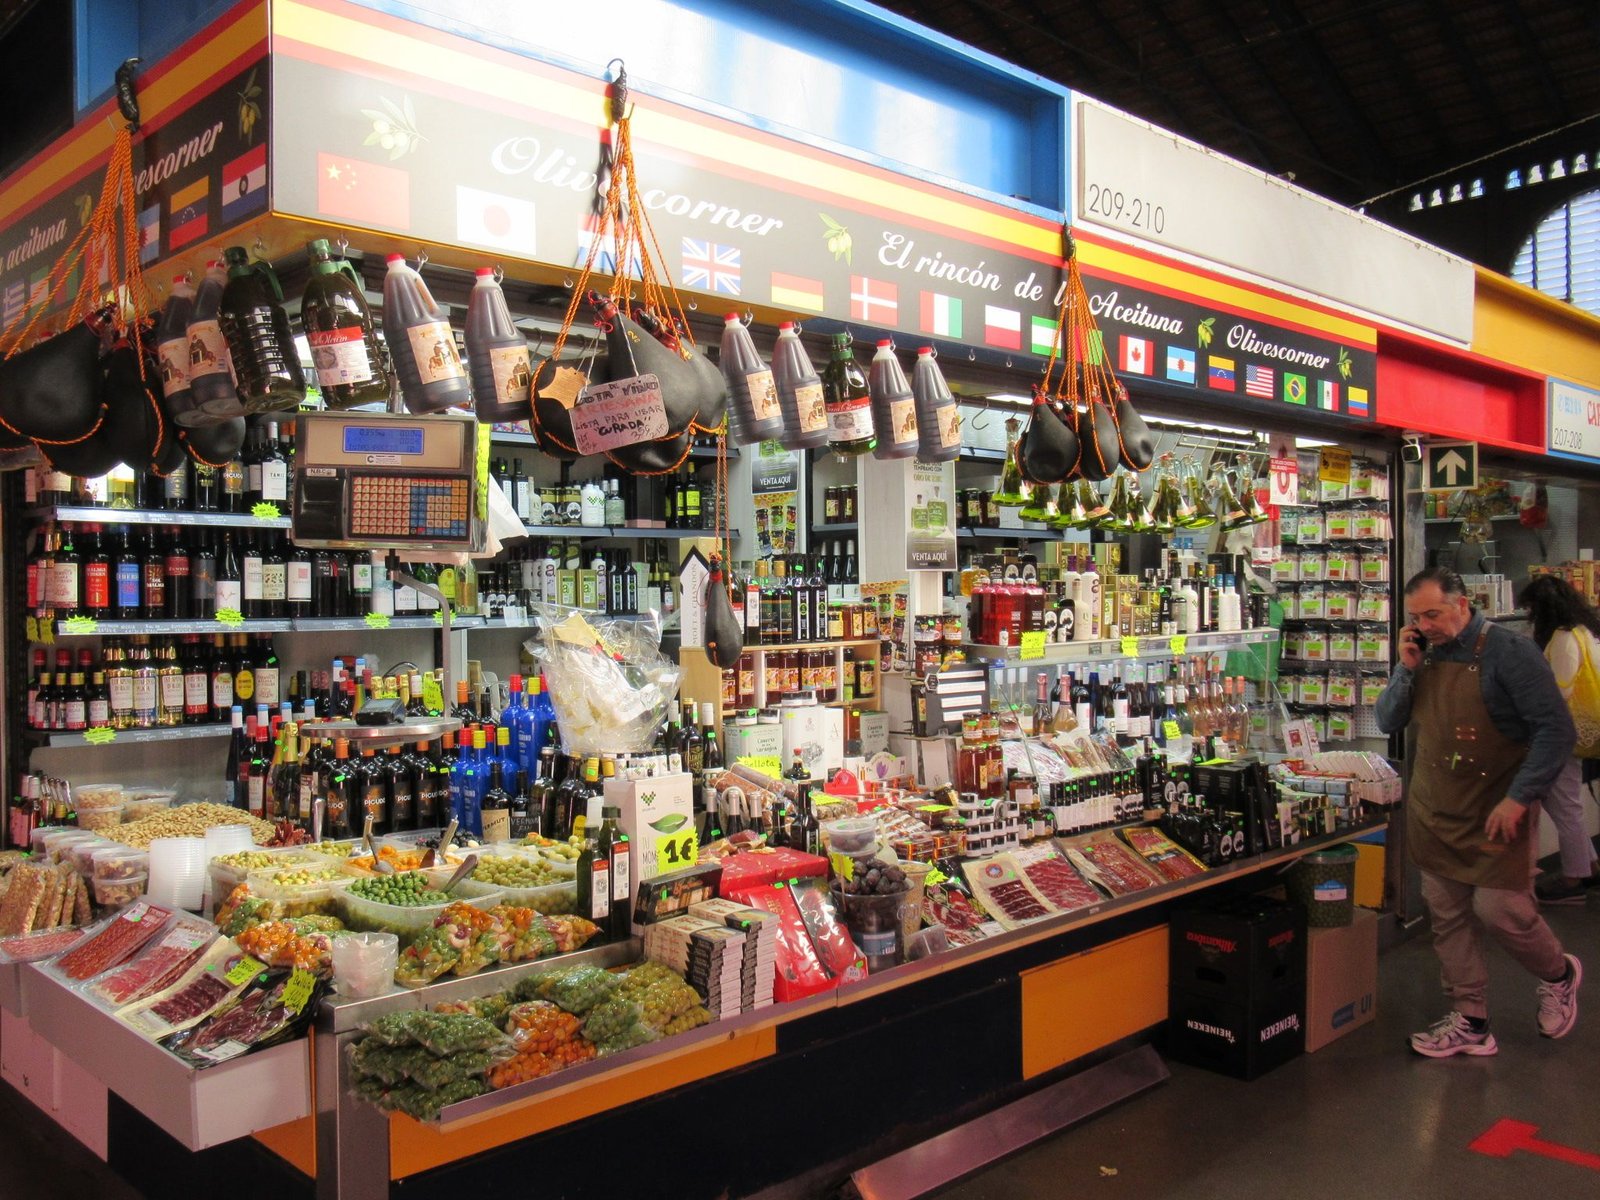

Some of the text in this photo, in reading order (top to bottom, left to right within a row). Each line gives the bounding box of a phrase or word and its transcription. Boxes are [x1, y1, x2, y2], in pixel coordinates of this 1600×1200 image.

[490, 136, 784, 237] Olivcorner
[1088, 183, 1165, 234] 209-210
[7, 218, 68, 271] aceituna
[877, 230, 914, 270] El
[914, 254, 1002, 293] rincón
[1014, 271, 1044, 302] de
[1088, 290, 1185, 336] Aceituna
[1226, 323, 1331, 370] Olivescorner
[575, 405, 664, 431] LISTA PARA USAR
[1553, 427, 1583, 450] 207-208
[760, 477, 778, 486] VENTA
[911, 549, 947, 562] VENTA AQUÍ
[744, 759, 775, 768] Bellota
[664, 837, 694, 863] 1€
[1187, 1019, 1232, 1039] HEINEKEN
[1260, 1013, 1297, 1043] HEINEKEN
